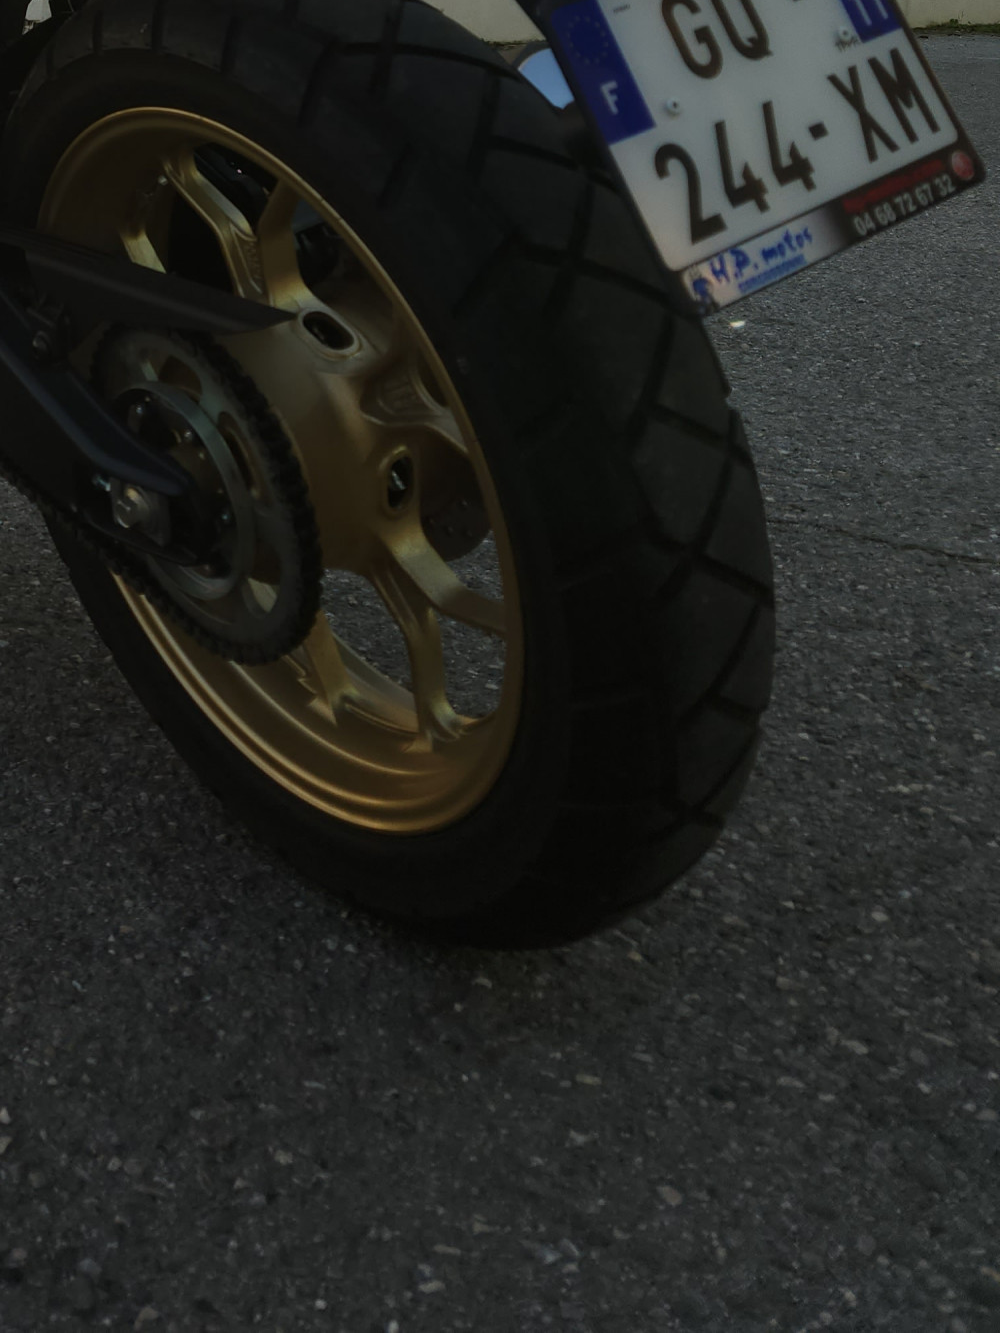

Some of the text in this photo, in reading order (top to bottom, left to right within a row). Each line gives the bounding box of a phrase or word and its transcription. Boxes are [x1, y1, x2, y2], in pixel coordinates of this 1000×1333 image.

[600, 80, 619, 115] F
[653, 47, 940, 245] 244-XM
[853, 210, 877, 236] 04
[873, 201, 897, 227] 68
[893, 192, 917, 216] 72
[914, 181, 935, 207] 67
[933, 173, 956, 197] 32
